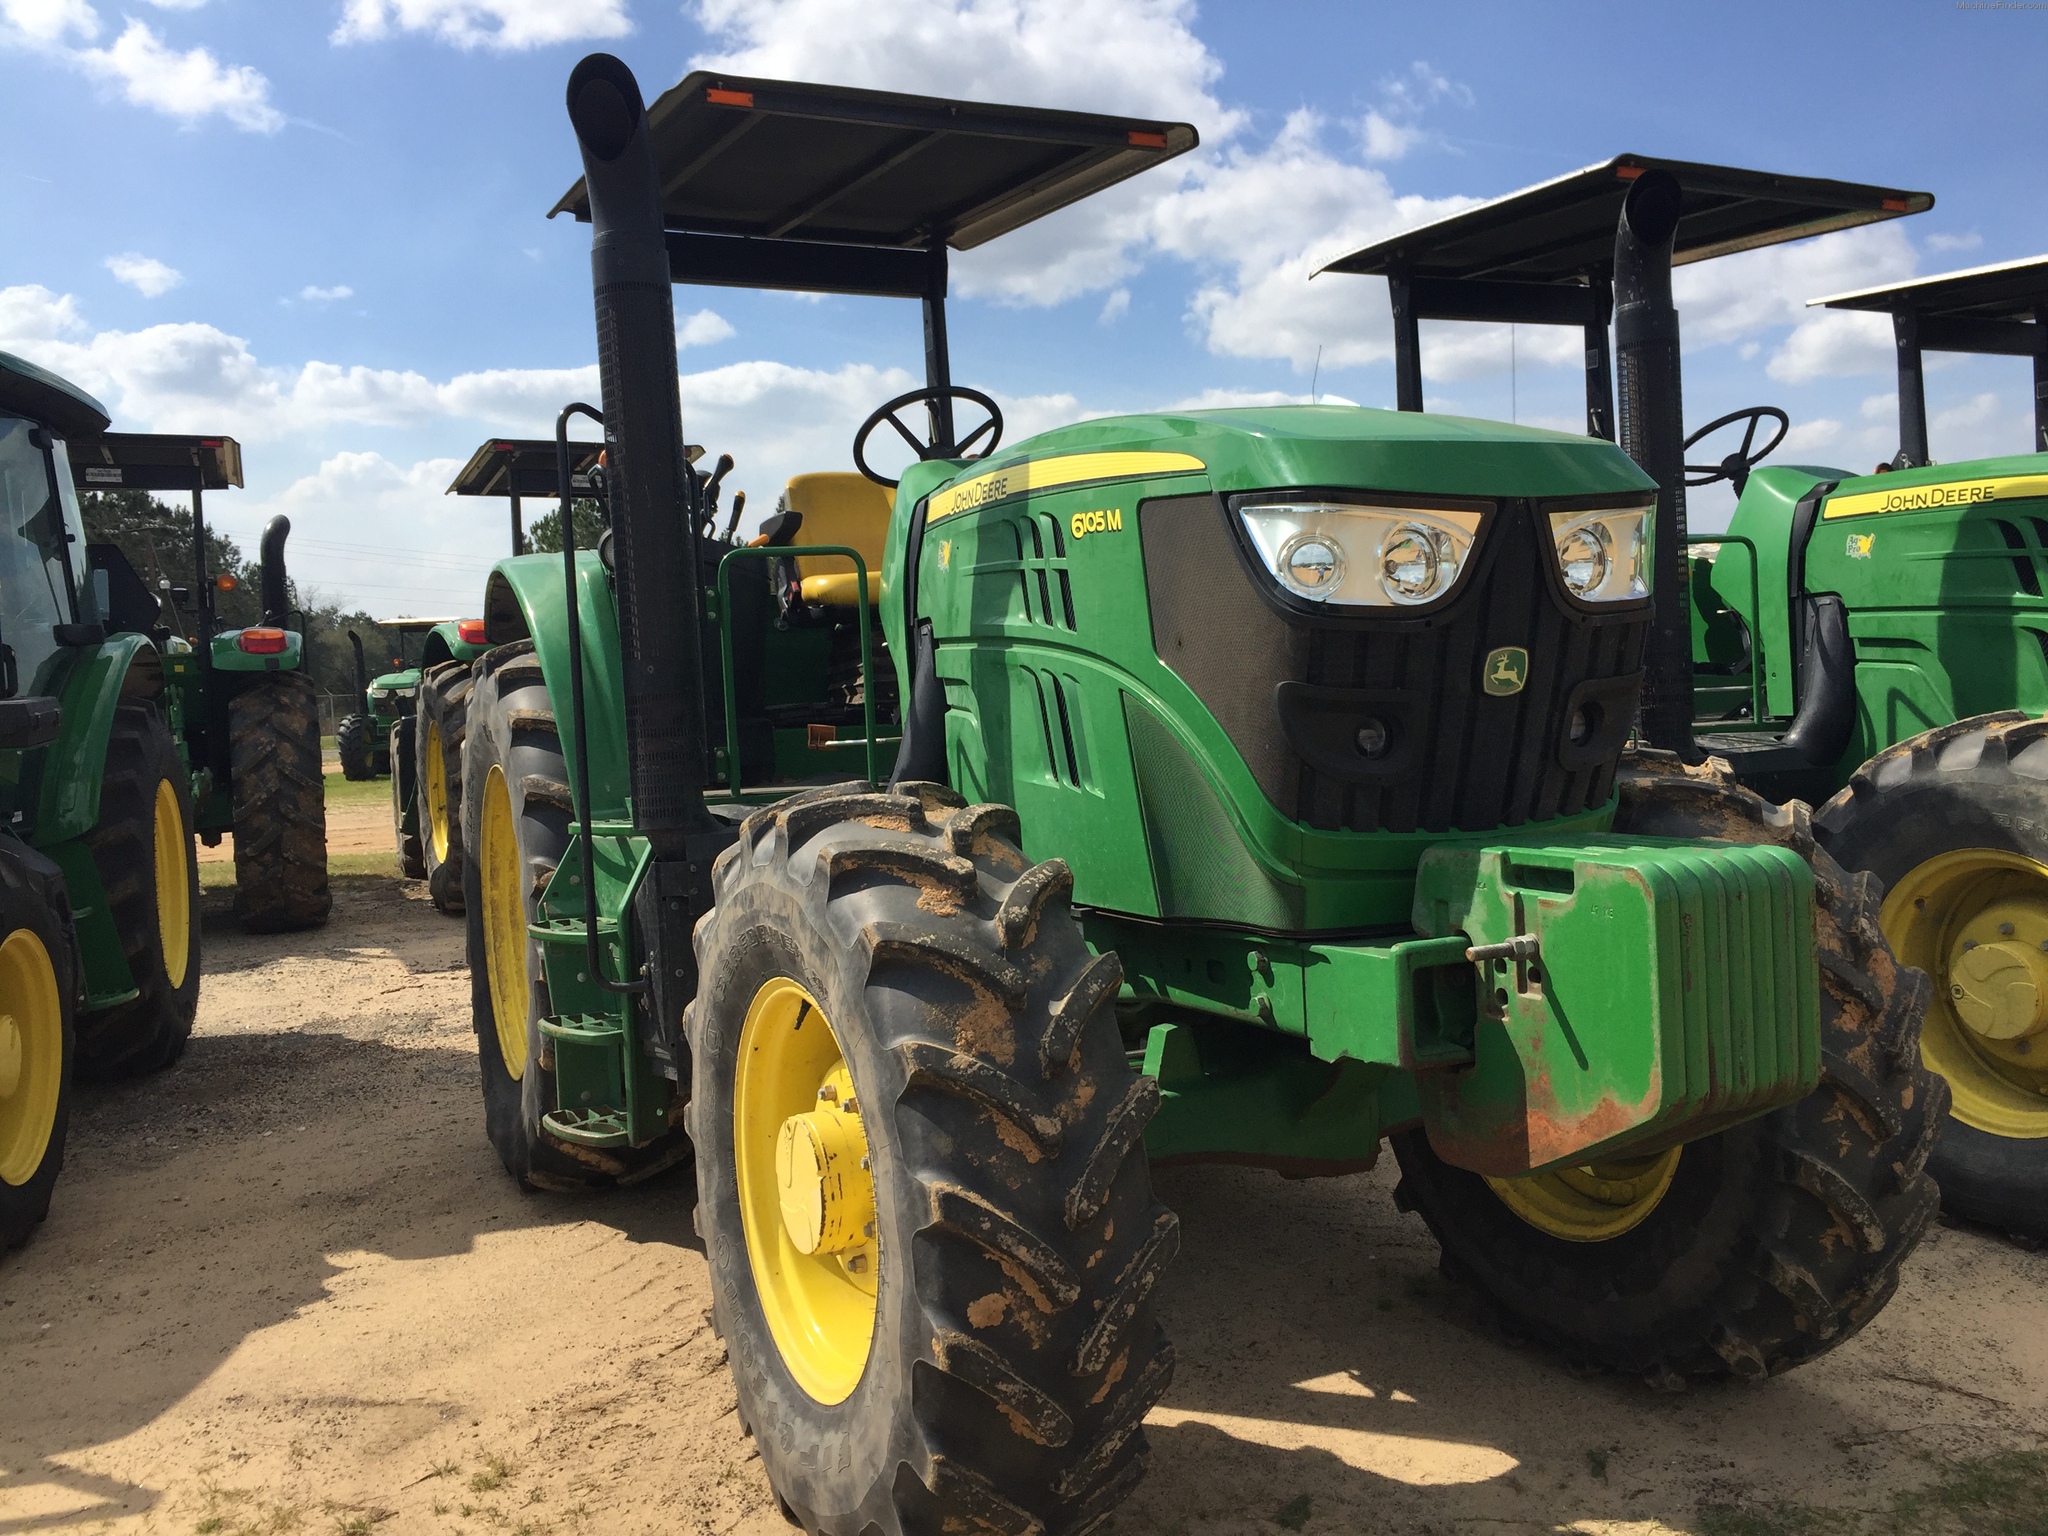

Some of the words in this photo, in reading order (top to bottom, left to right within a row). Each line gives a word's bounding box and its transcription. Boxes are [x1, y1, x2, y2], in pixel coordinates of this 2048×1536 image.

[951, 487, 975, 512] JOHN
[975, 477, 1008, 504] DEERE
[1880, 493, 1928, 511] JOHN
[1931, 486, 1995, 506] DEERE
